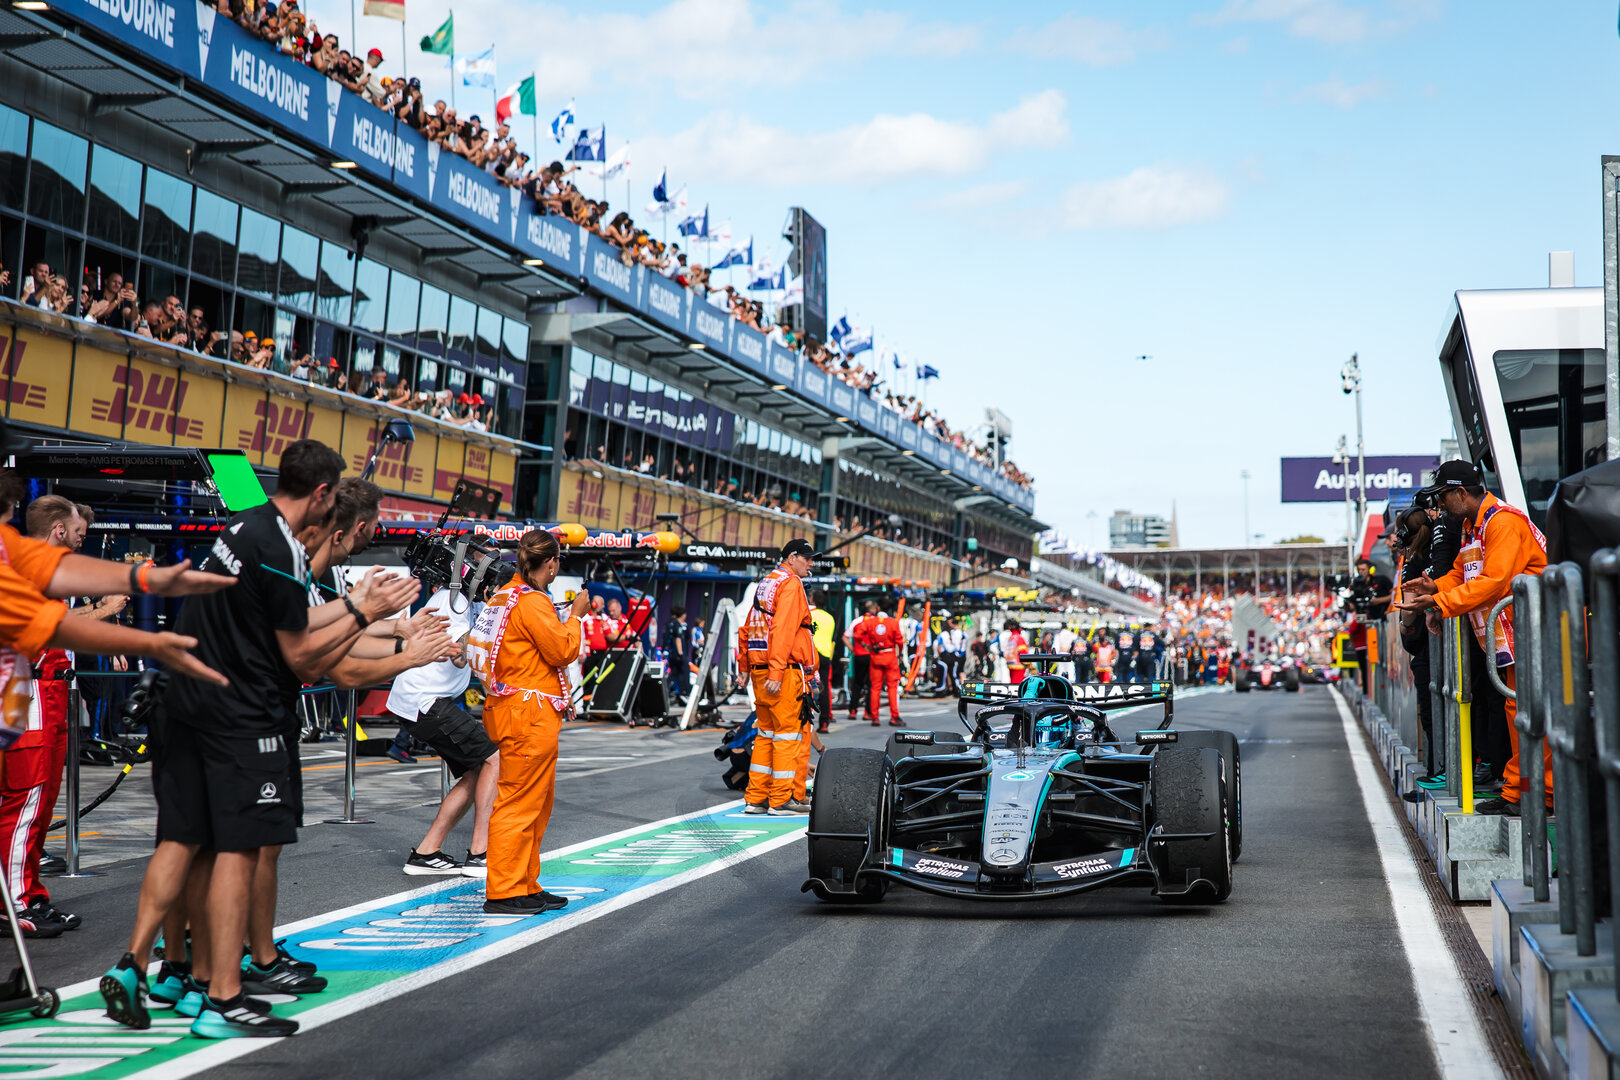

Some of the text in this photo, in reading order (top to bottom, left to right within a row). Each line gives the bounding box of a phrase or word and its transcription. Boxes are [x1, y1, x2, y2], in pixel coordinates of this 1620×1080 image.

[83, 0, 176, 48] OURNE
[230, 43, 310, 121] MELBOURNE
[352, 113, 416, 178] MELBOURNE
[448, 170, 501, 224] MELBOURNE
[527, 215, 571, 261] MELBOURNE
[592, 251, 631, 293] MELBOURNE
[107, 365, 189, 438] DHL
[111, 456, 154, 465] PETRONAS
[475, 525, 505, 540] Red
[582, 533, 632, 548] ed Bull
[990, 685, 1146, 703] PONAS
[910, 863, 964, 878] Syntium
[918, 858, 970, 871] PETRONAS
[1052, 858, 1107, 872] PETRONAS
[1057, 864, 1113, 878] Syntium
[297, 885, 606, 950] aramo
